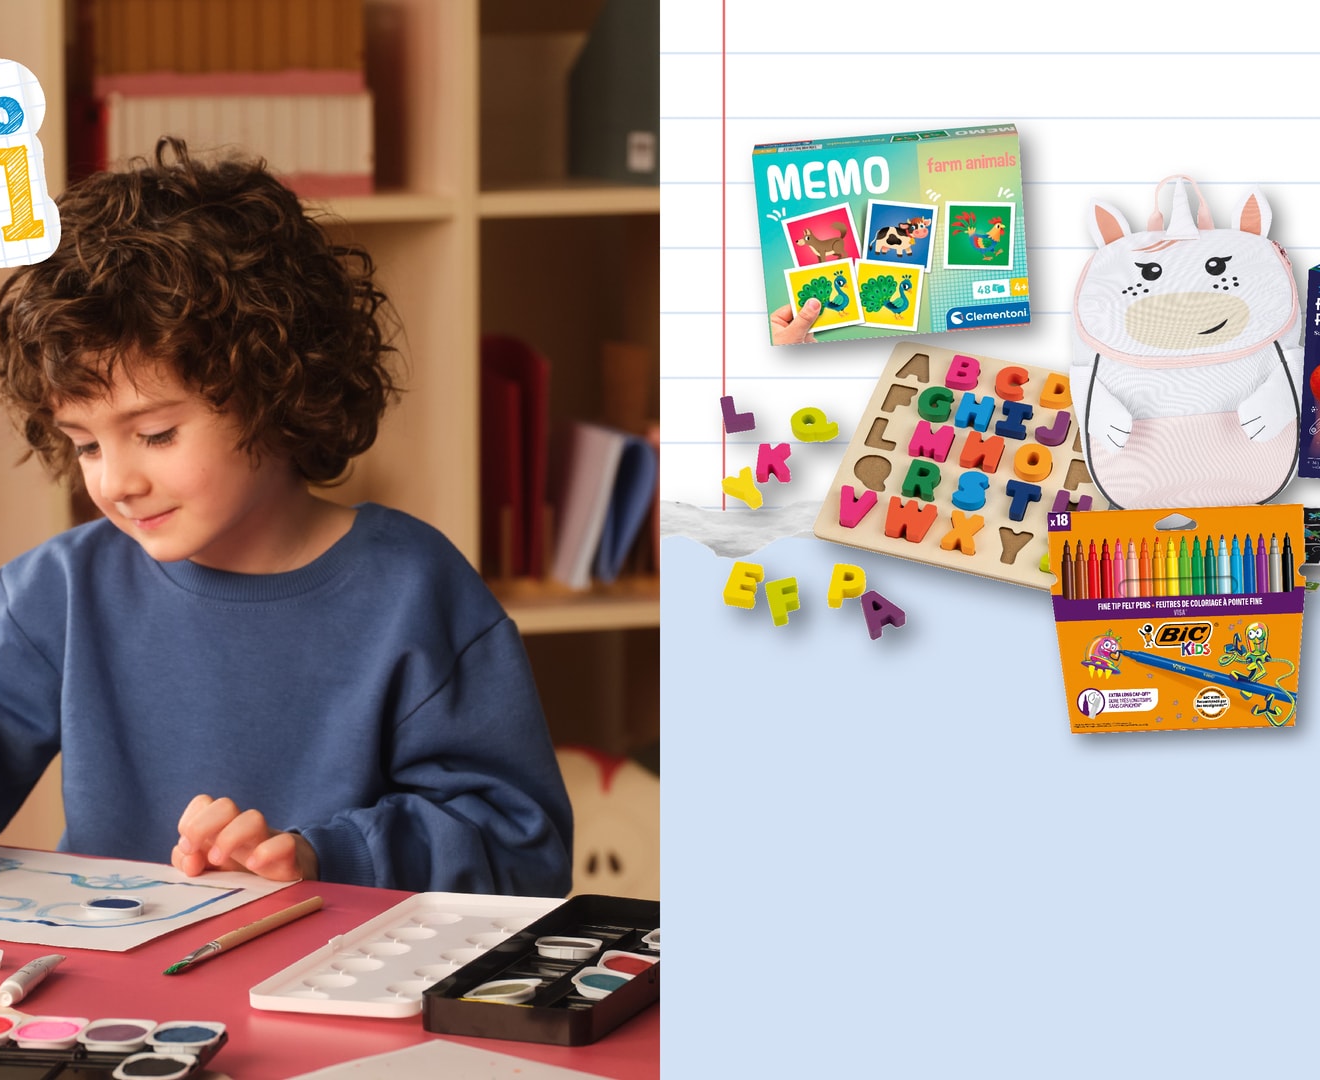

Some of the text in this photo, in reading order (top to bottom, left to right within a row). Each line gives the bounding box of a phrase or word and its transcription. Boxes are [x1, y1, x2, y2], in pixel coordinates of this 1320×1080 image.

[766, 155, 890, 203] MEMO
[927, 152, 1017, 174] farm animals
[977, 283, 991, 295] 48
[1014, 282, 1028, 293] 4+
[965, 307, 1027, 323] Clementoni
[895, 353, 1073, 408] A B C D
[720, 396, 756, 434] L
[918, 386, 954, 423] G
[954, 392, 995, 432] H
[995, 400, 1033, 440] I
[1034, 411, 1071, 446] J
[756, 443, 791, 483] K
[908, 421, 955, 462] M
[1013, 443, 1053, 482] O
[901, 459, 941, 502] R
[952, 471, 989, 511] S
[1006, 479, 1042, 521] T
[839, 485, 1034, 564] V W X Y
[1050, 514, 1068, 527] x18
[723, 561, 764, 609] E
[765, 577, 800, 627] F
[827, 563, 867, 609] P
[1098, 602, 1111, 610] FINE
[1112, 602, 1121, 610] TIP
[1122, 602, 1135, 610] FELT
[1135, 601, 1151, 609] PENS
[1155, 600, 1181, 608] FEUTRES
[1190, 598, 1222, 607] COLORIAGE
[1223, 597, 1227, 606] À
[1228, 598, 1249, 606] POINTE
[1250, 597, 1263, 605] FINE
[860, 590, 907, 641] A
